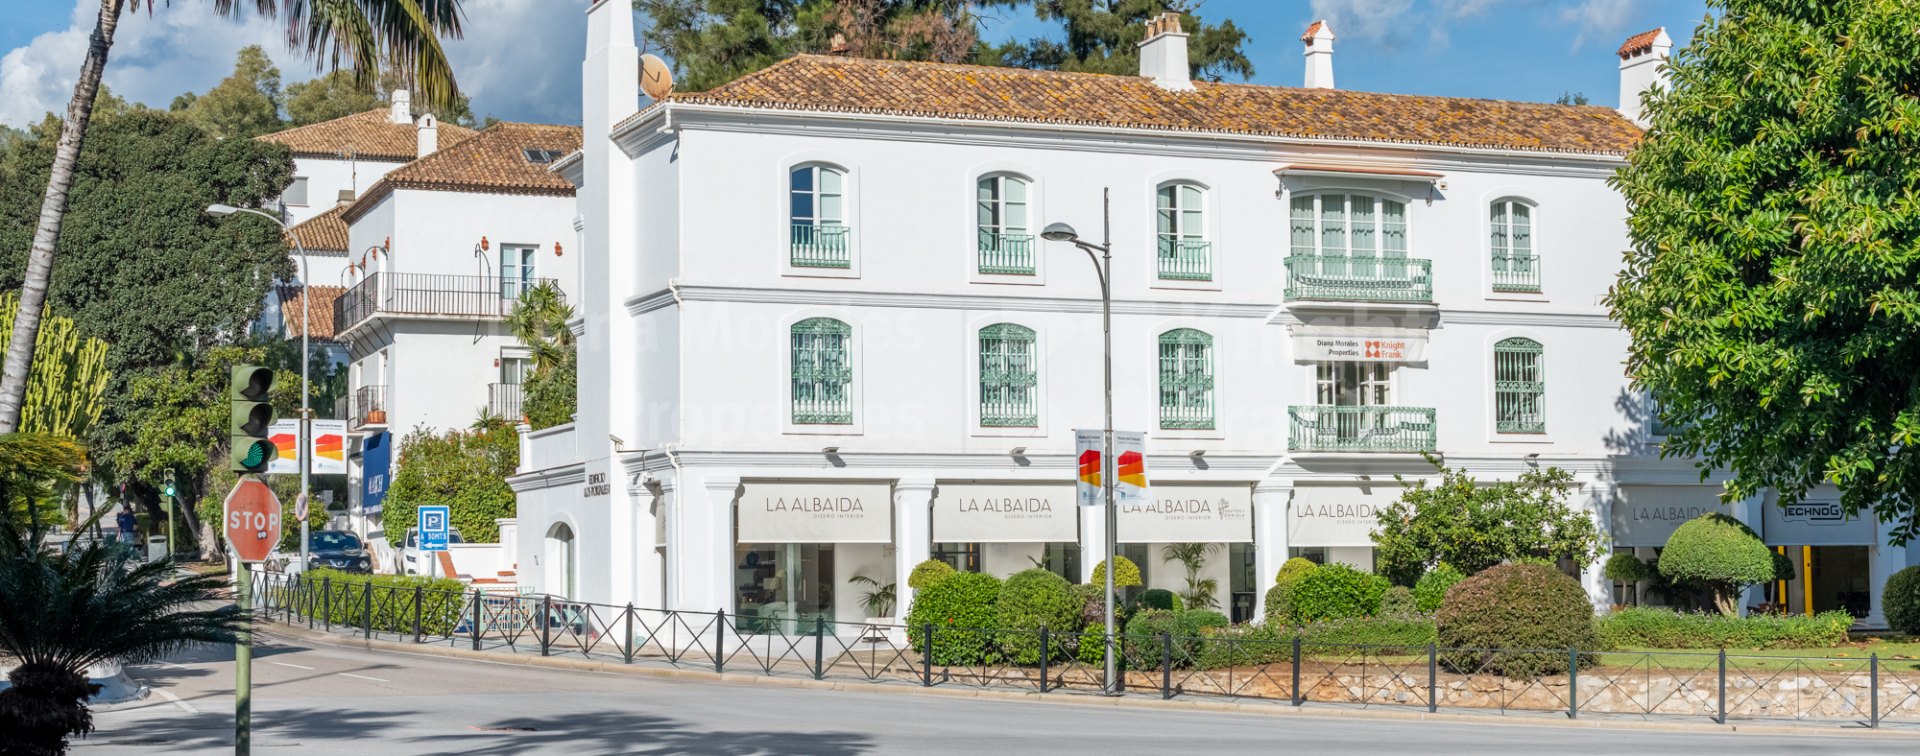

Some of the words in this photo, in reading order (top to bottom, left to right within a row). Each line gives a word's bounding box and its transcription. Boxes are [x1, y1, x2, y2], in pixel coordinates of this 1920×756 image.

[1328, 348, 1359, 357] Properties
[1381, 341, 1405, 351] Knight
[766, 497, 787, 512] LA
[791, 497, 864, 512] ALBAIDA
[959, 498, 979, 513] LA
[983, 498, 1052, 513] ALBAIDA
[1145, 499, 1211, 514] ALBAIDA
[1296, 504, 1315, 518] LA
[230, 510, 278, 531] STOP
[1633, 507, 1650, 521] LA
[428, 516, 438, 527] P
